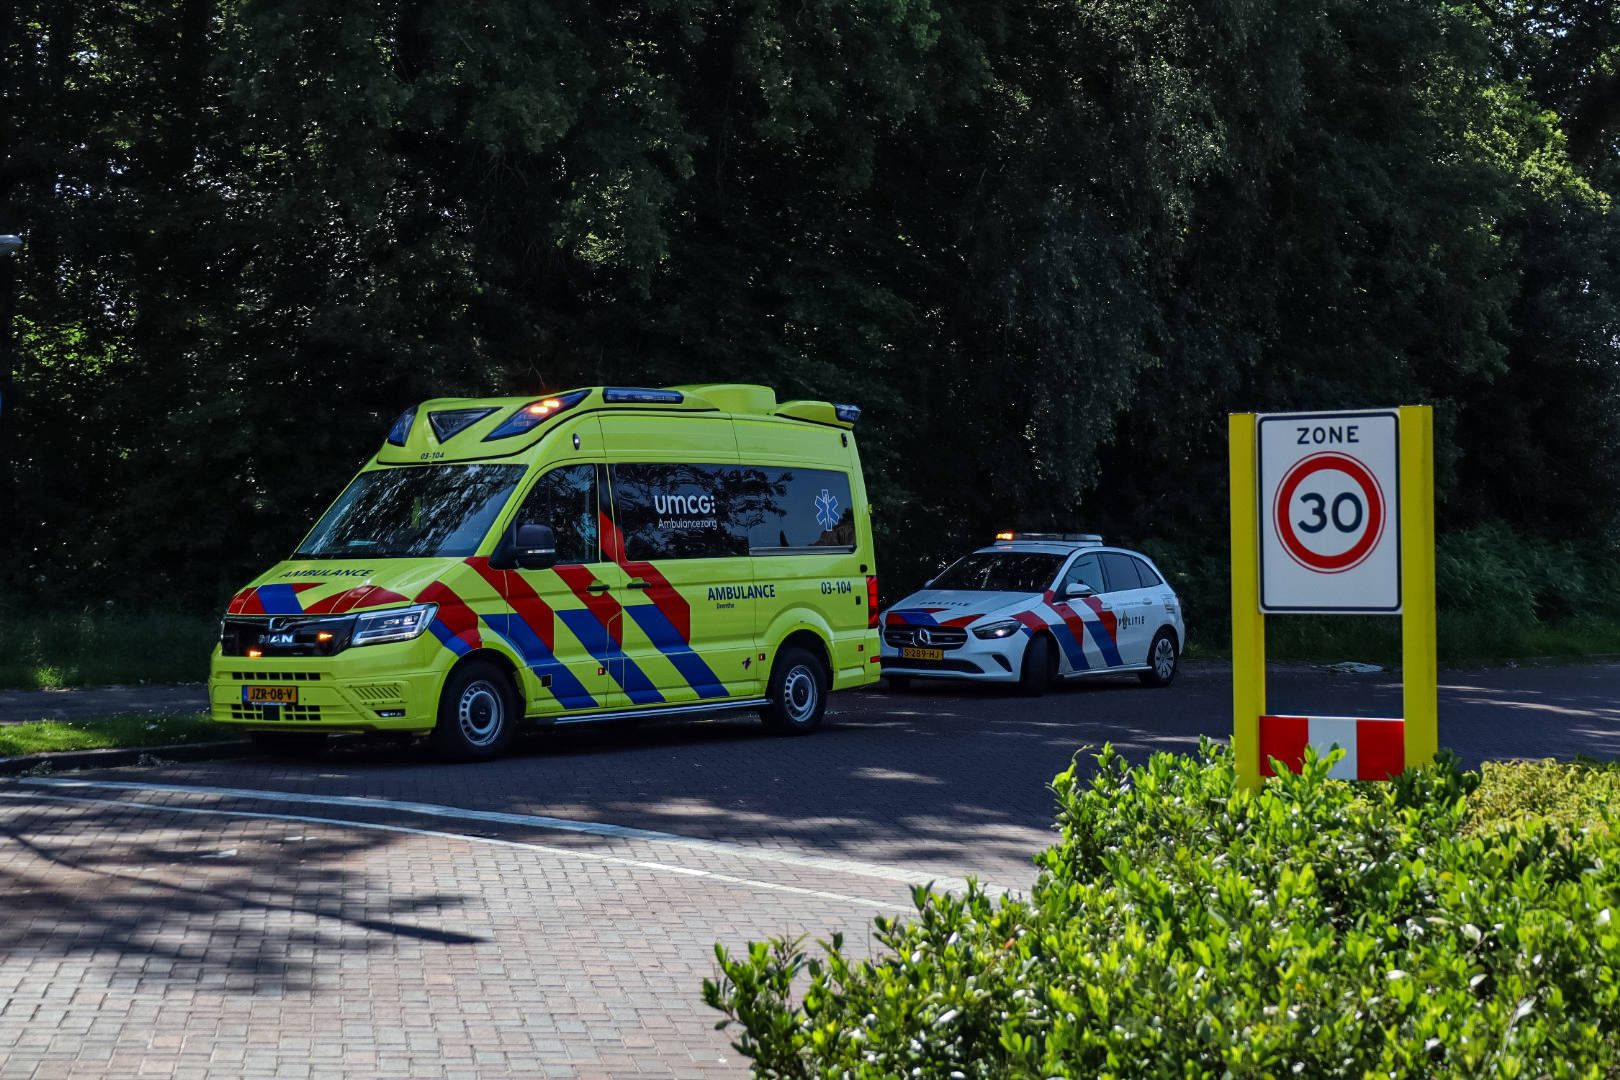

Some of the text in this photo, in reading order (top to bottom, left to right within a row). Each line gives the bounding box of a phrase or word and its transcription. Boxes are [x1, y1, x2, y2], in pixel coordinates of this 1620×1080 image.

[1297, 426, 1359, 444] ZONE
[1298, 492, 1363, 534] 30
[658, 518, 717, 530] Ambulancezorg
[280, 569, 375, 578] AMBULANCE
[707, 584, 776, 601] AMBULANCE
[821, 581, 852, 594] 03-104
[251, 688, 293, 700] JZR-08-V
